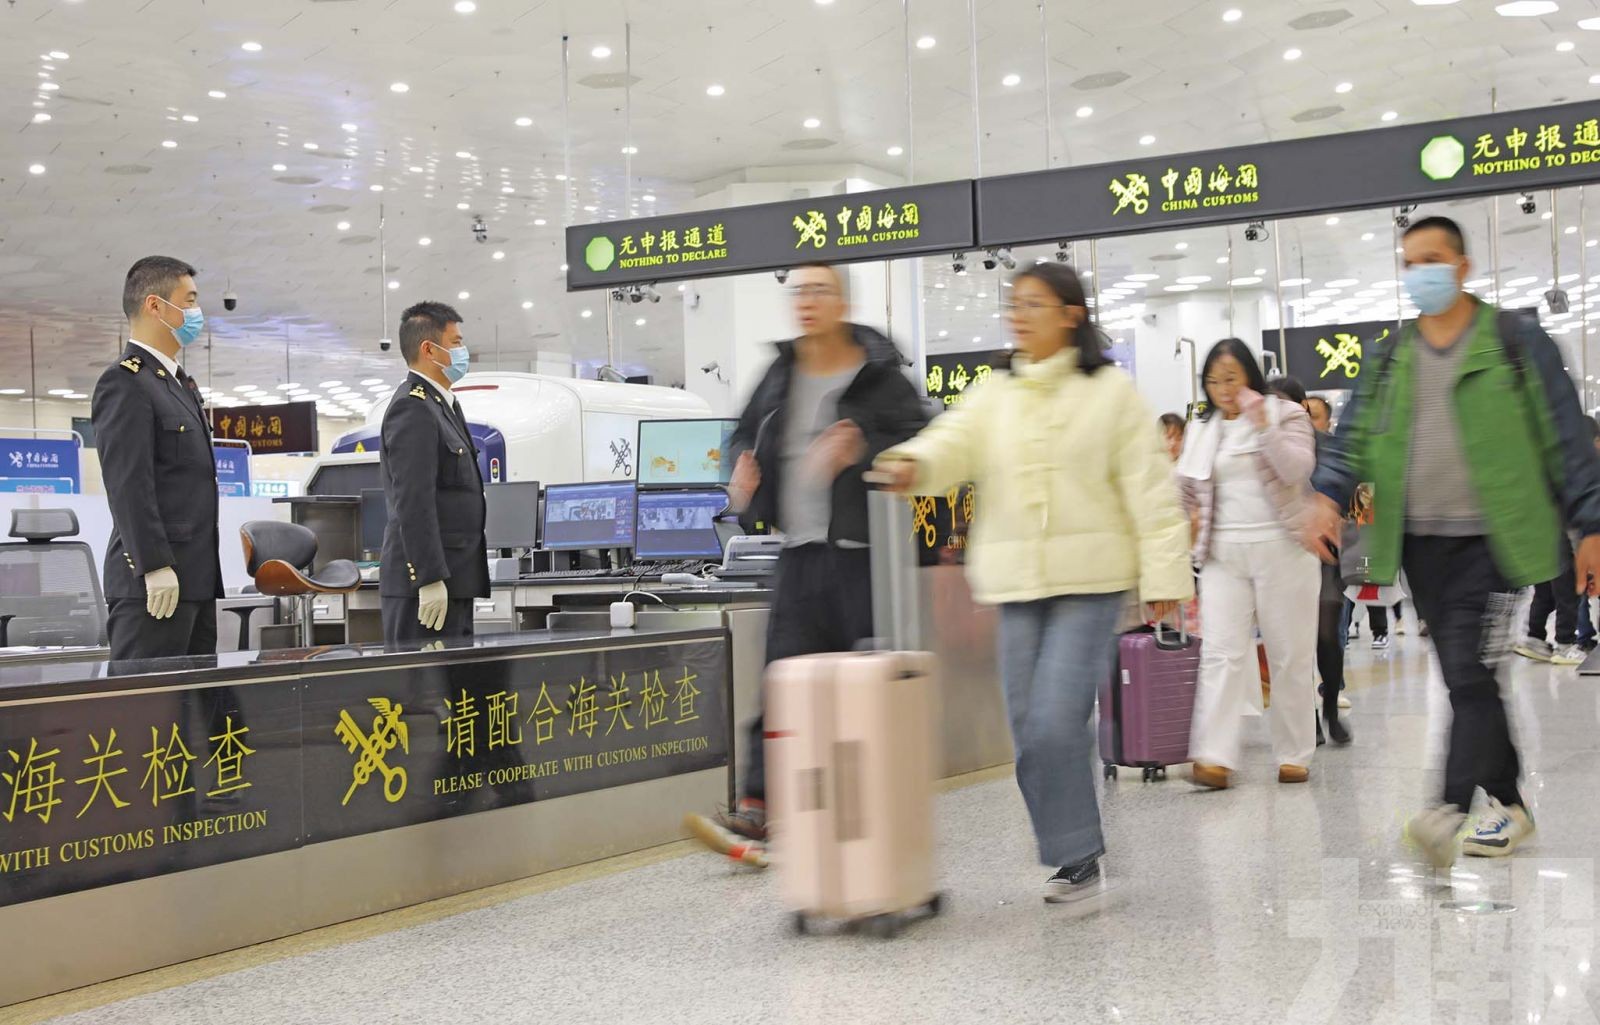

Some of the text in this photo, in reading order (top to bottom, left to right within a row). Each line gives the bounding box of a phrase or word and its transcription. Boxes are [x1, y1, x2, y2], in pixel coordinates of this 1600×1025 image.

[1471, 118, 1600, 160] 无申报通
[1473, 156, 1540, 176] NOTHING
[1545, 153, 1566, 168] TO
[1161, 191, 1259, 212] CHINA CUSTOMS
[618, 223, 728, 257] 无申报通道
[836, 228, 919, 247] CHINA CUSTOMS
[619, 247, 728, 270] NOTHING TO DECLARE
[440, 665, 702, 759] 请配合海关检查
[1, 715, 257, 825] 海关检查
[433, 735, 709, 796] PLEASE COOPERATE WITH CUSTOMS INSPECTION
[0, 809, 268, 873] WITH CUSTOMS INSPECTION
